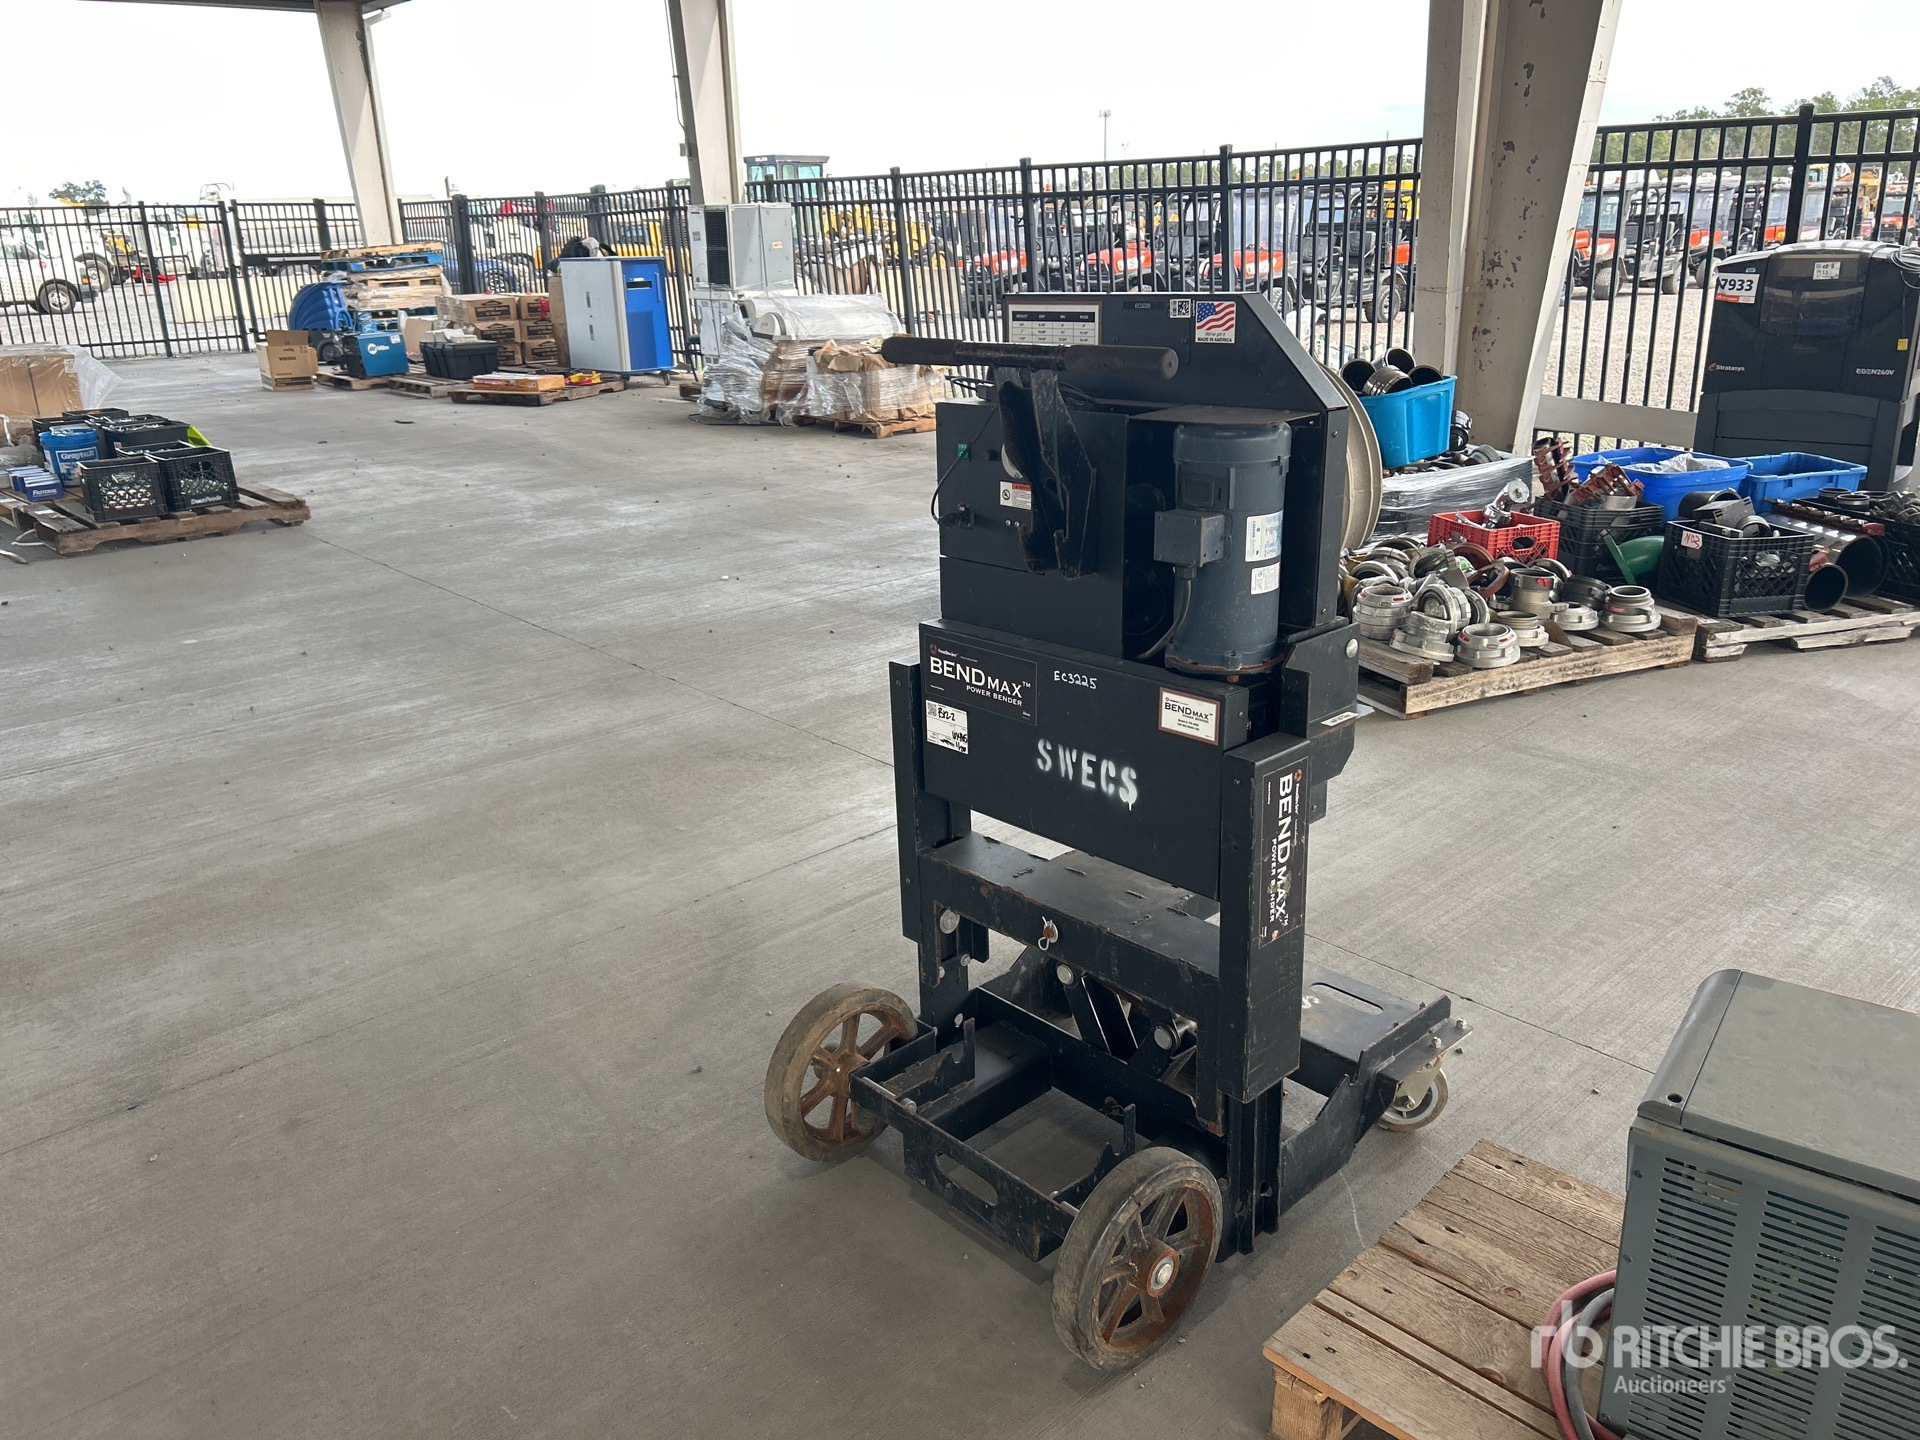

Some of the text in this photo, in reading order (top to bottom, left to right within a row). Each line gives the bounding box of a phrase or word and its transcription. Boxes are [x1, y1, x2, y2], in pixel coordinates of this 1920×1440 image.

[1715, 364, 1745, 372] Stratasys
[1855, 368, 1895, 376] EDEN260V
[1053, 670, 1097, 690] EC3225
[966, 685, 1023, 707] POWER BENDER
[1037, 738, 1138, 808] SWECS
